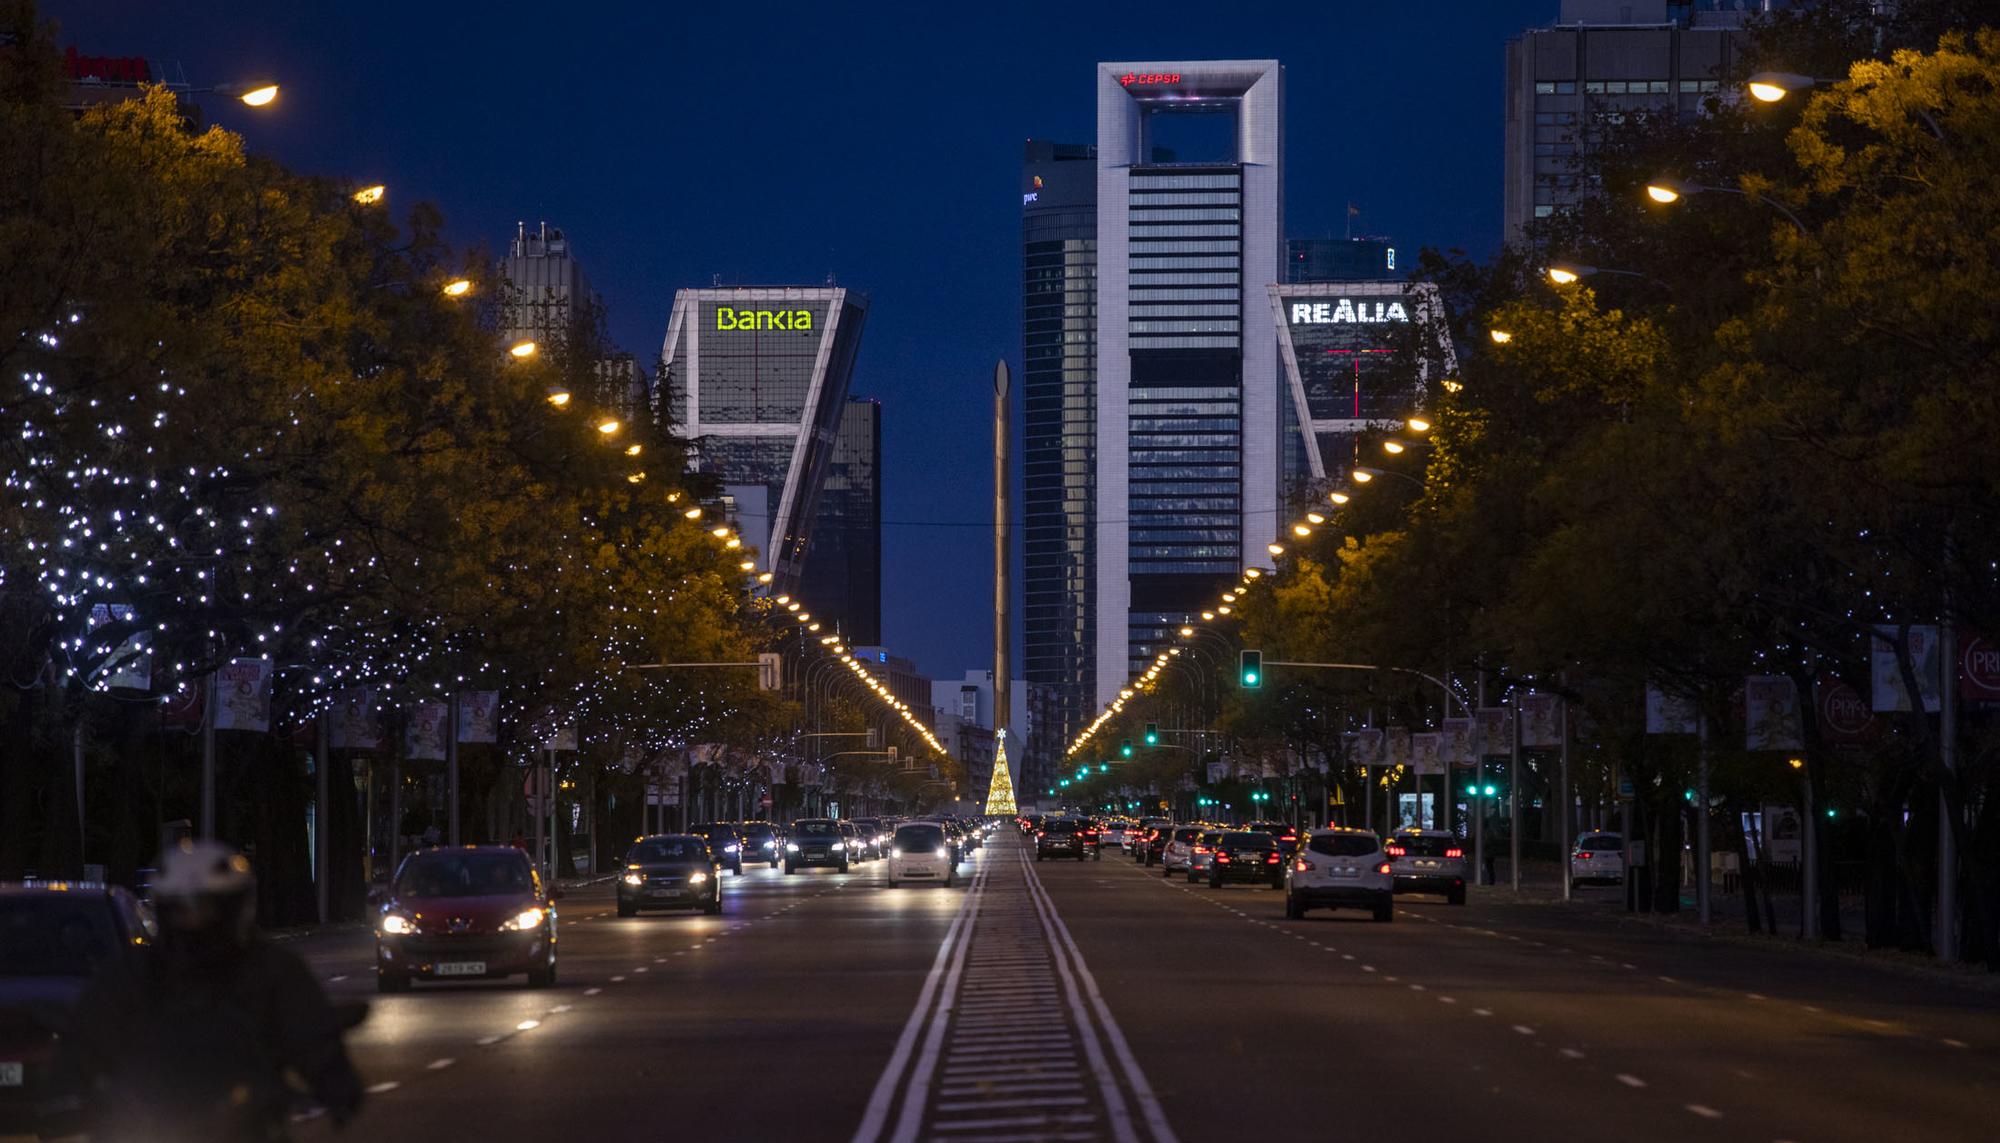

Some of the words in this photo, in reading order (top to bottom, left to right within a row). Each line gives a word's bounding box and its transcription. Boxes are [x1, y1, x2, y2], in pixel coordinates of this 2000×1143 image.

[1138, 73, 1181, 85] CEPSA
[1023, 192, 1038, 206] pwc
[717, 307, 812, 330] Bankia
[1292, 299, 1409, 324] REALIA
